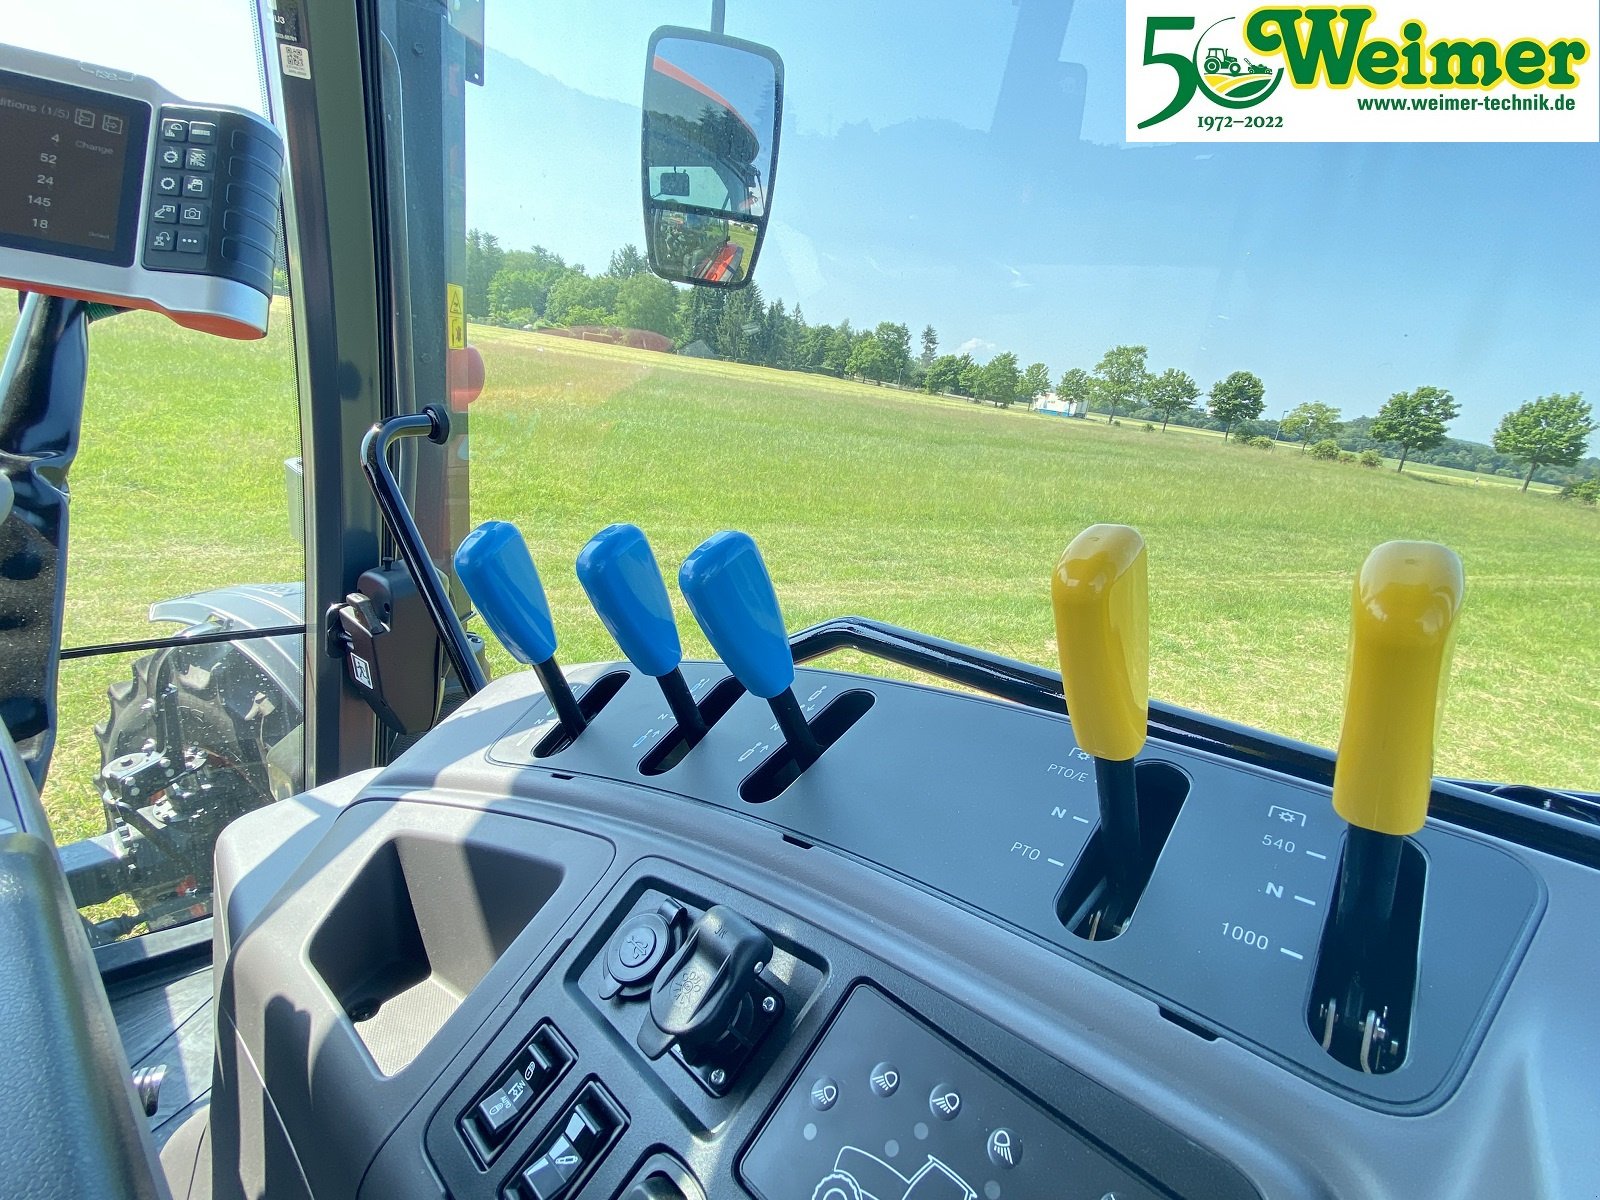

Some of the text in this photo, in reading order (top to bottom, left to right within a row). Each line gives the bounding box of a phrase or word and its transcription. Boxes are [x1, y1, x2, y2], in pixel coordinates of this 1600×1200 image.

[50, 133, 60, 143] 4
[75, 139, 114, 155] Change
[40, 152, 57, 165] 52
[37, 174, 54, 186] 24
[27, 195, 52, 208] 145
[32, 217, 48, 230] 18
[1047, 762, 1089, 783] PTO/E
[1051, 806, 1067, 820] N
[1010, 841, 1042, 861] PTO
[1262, 834, 1296, 854] 540
[1265, 882, 1284, 900] N
[1220, 922, 1269, 951] 1000
